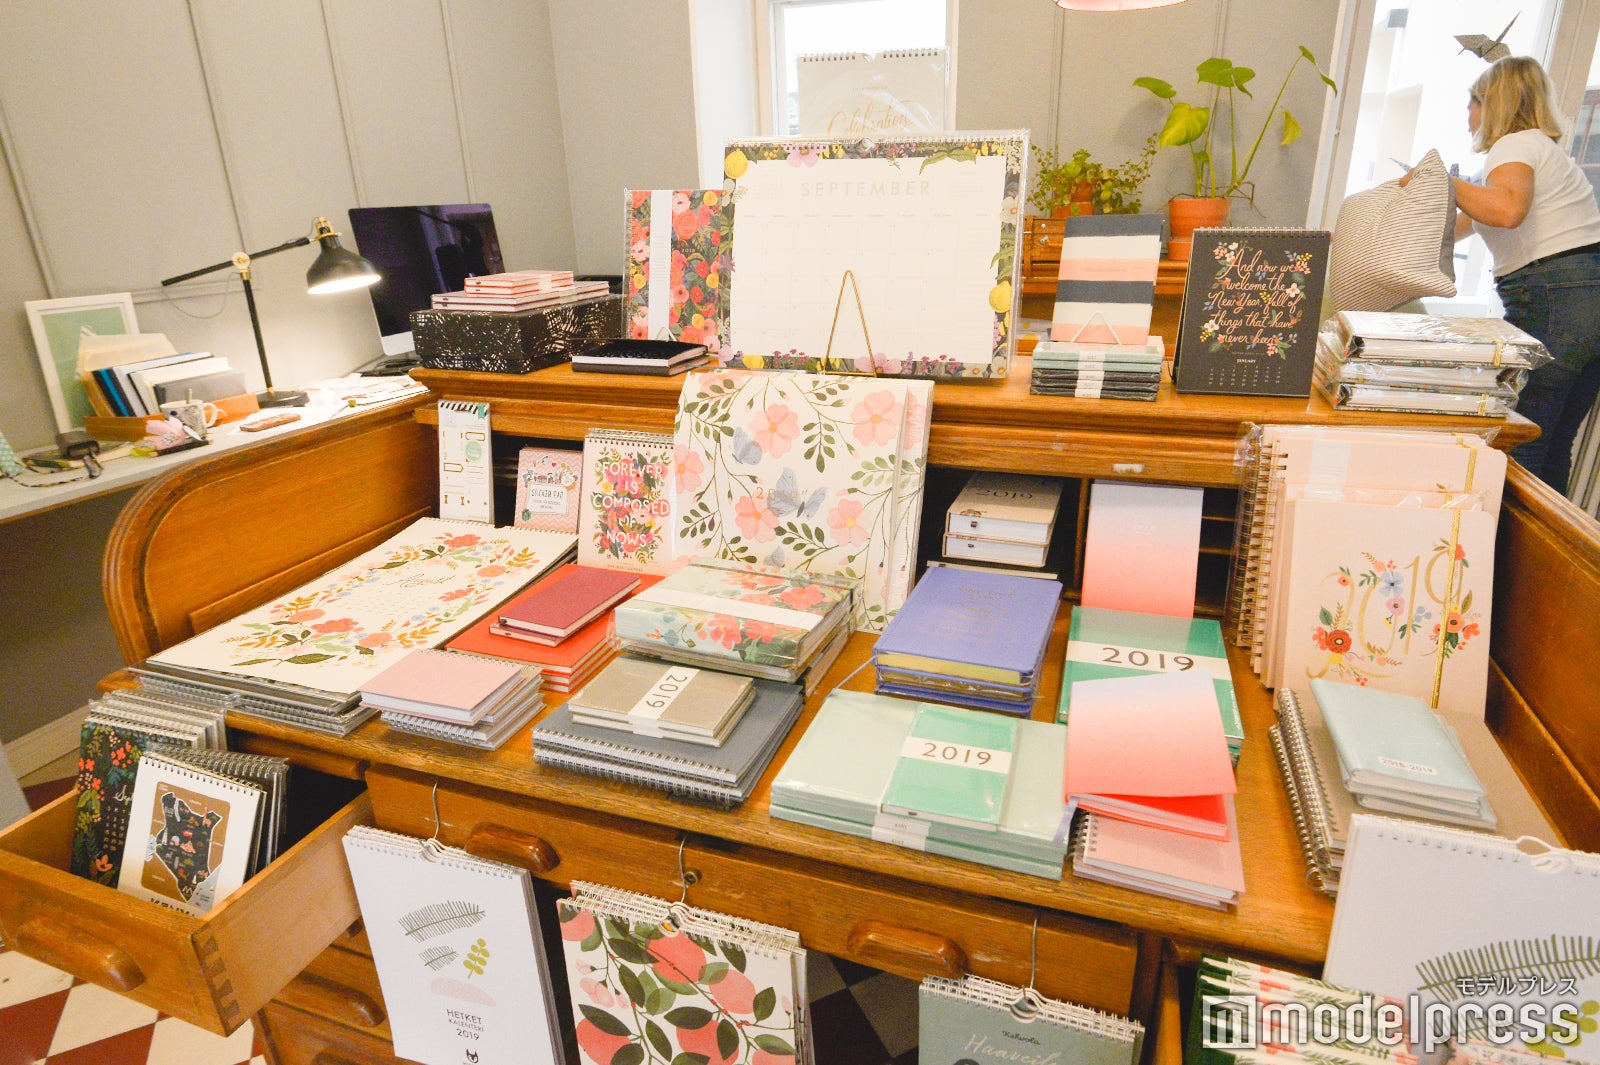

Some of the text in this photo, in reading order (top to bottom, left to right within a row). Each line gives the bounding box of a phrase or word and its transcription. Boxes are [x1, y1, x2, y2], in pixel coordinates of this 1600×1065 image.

[800, 180, 931, 197] SEPTEMBER
[1215, 248, 1296, 280] And now we
[1226, 273, 1286, 291] welcome the
[1207, 290, 1238, 309] New
[1287, 293, 1304, 314] of
[1210, 310, 1294, 335] things that have
[1221, 334, 1250, 344] never
[601, 461, 663, 479] FOREVER
[531, 488, 552, 498] STICKER
[624, 480, 639, 495] IS
[974, 488, 1034, 500] 2019
[592, 494, 671, 516] COMPOSED
[618, 514, 637, 528] OF
[606, 530, 648, 548] NOWS
[1306, 551, 1467, 680] 2019
[1102, 647, 1195, 672] 2019
[646, 674, 689, 709] 2019
[921, 742, 992, 766] 2019
[446, 1008, 482, 1025] HETKET
[456, 1028, 480, 1041] 2019
